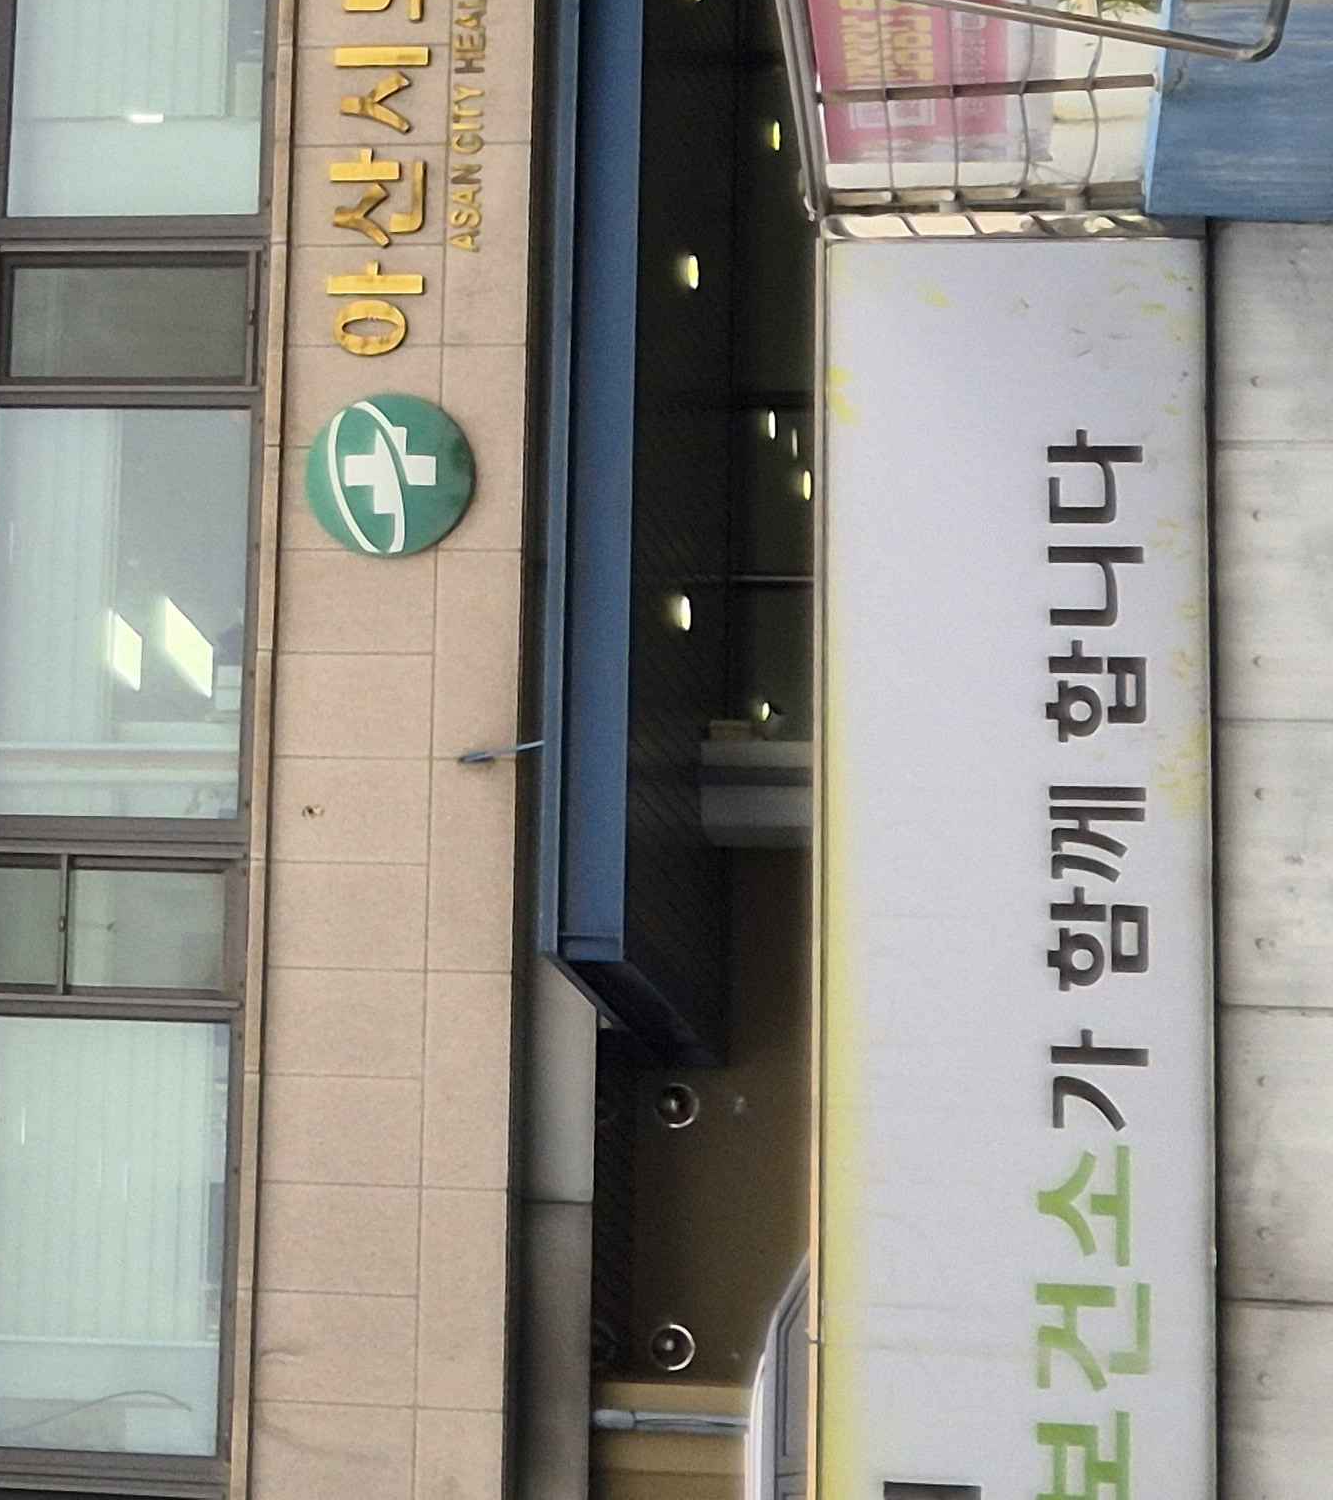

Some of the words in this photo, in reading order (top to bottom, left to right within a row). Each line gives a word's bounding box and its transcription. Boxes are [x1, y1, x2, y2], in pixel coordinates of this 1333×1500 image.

[451, 83, 484, 155] CITY
[448, 163, 482, 253] ASAN
[1045, 428, 1146, 743] 합니다
[1046, 785, 1148, 992] 함께
